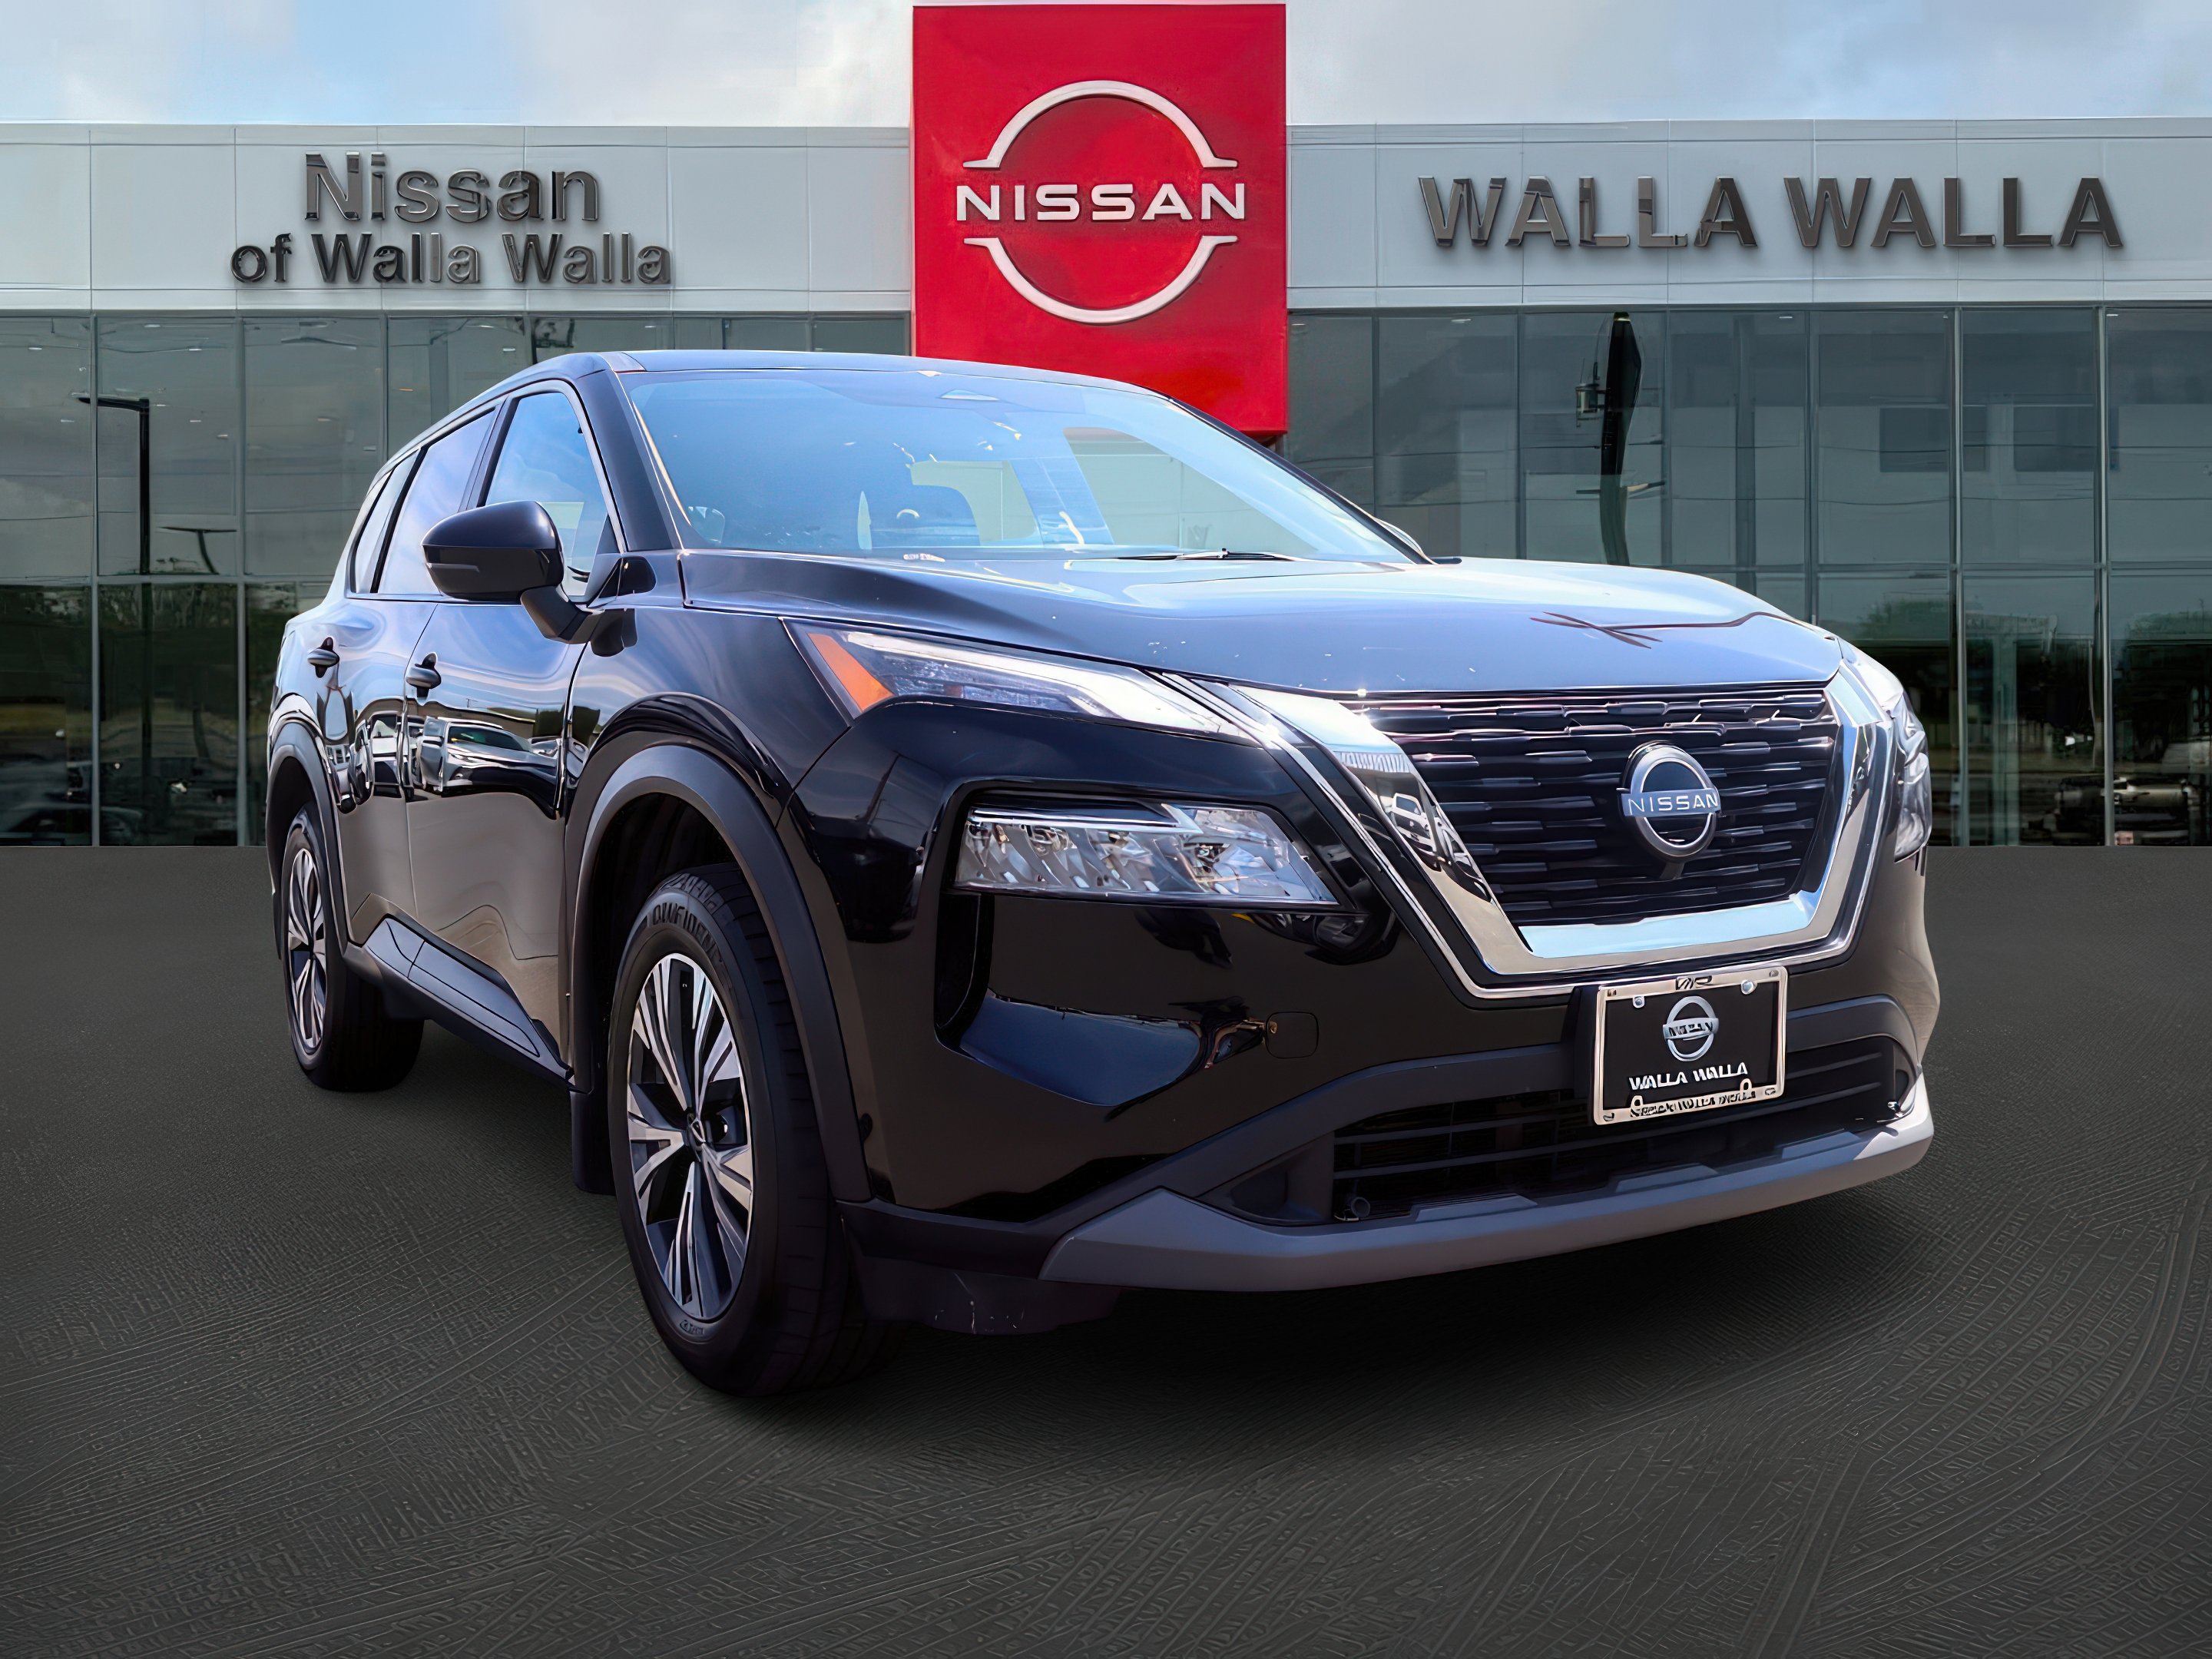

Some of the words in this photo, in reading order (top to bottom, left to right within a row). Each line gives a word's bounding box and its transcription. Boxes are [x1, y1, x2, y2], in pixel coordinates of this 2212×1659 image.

[305, 151, 600, 222] Nissan
[956, 183, 1246, 221] NISSAN
[1418, 175, 1758, 247] WALLA
[1783, 176, 2123, 247] WALLA
[230, 232, 292, 283] of
[310, 232, 481, 283] Walla
[502, 232, 671, 283] Walla
[1628, 793, 1718, 816] NISSAN
[1628, 1071, 1688, 1091] WALLA
[1692, 1061, 1749, 1082] WALLA
